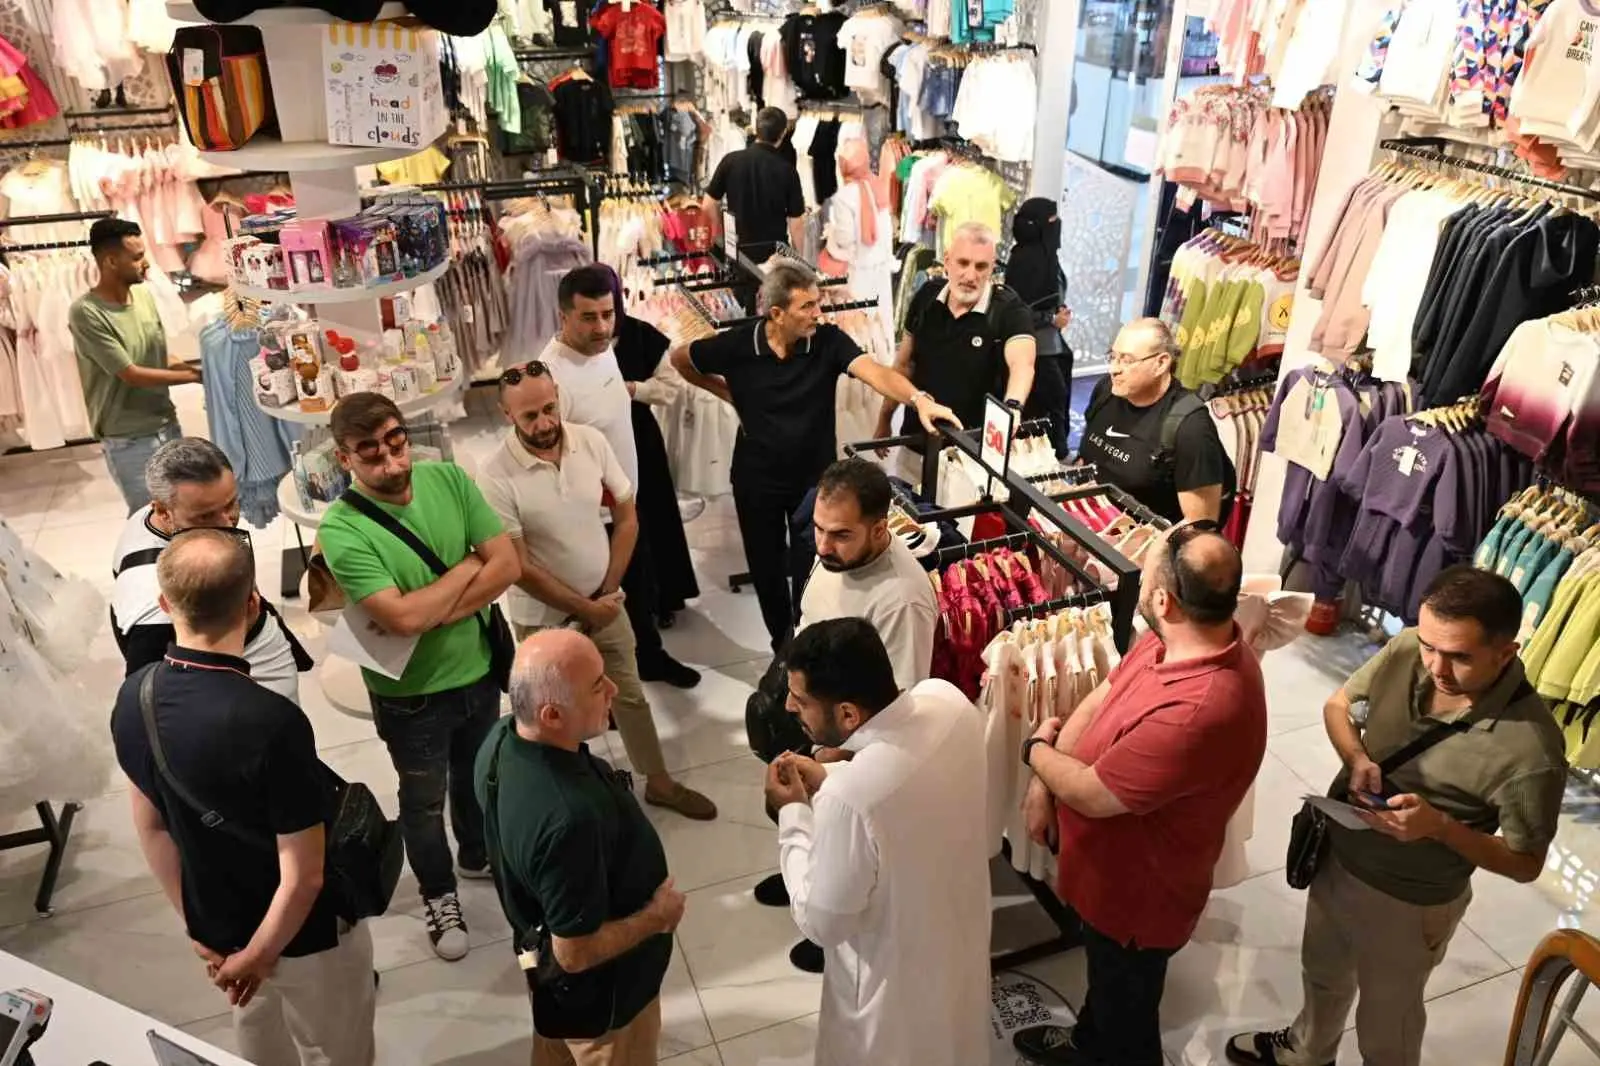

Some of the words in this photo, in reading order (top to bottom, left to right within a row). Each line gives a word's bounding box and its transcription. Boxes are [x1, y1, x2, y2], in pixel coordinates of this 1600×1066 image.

[369, 92, 411, 110] head
[367, 125, 420, 147] clouds
[1089, 432, 1104, 448] LAS
[1104, 443, 1130, 462] VEGAS
